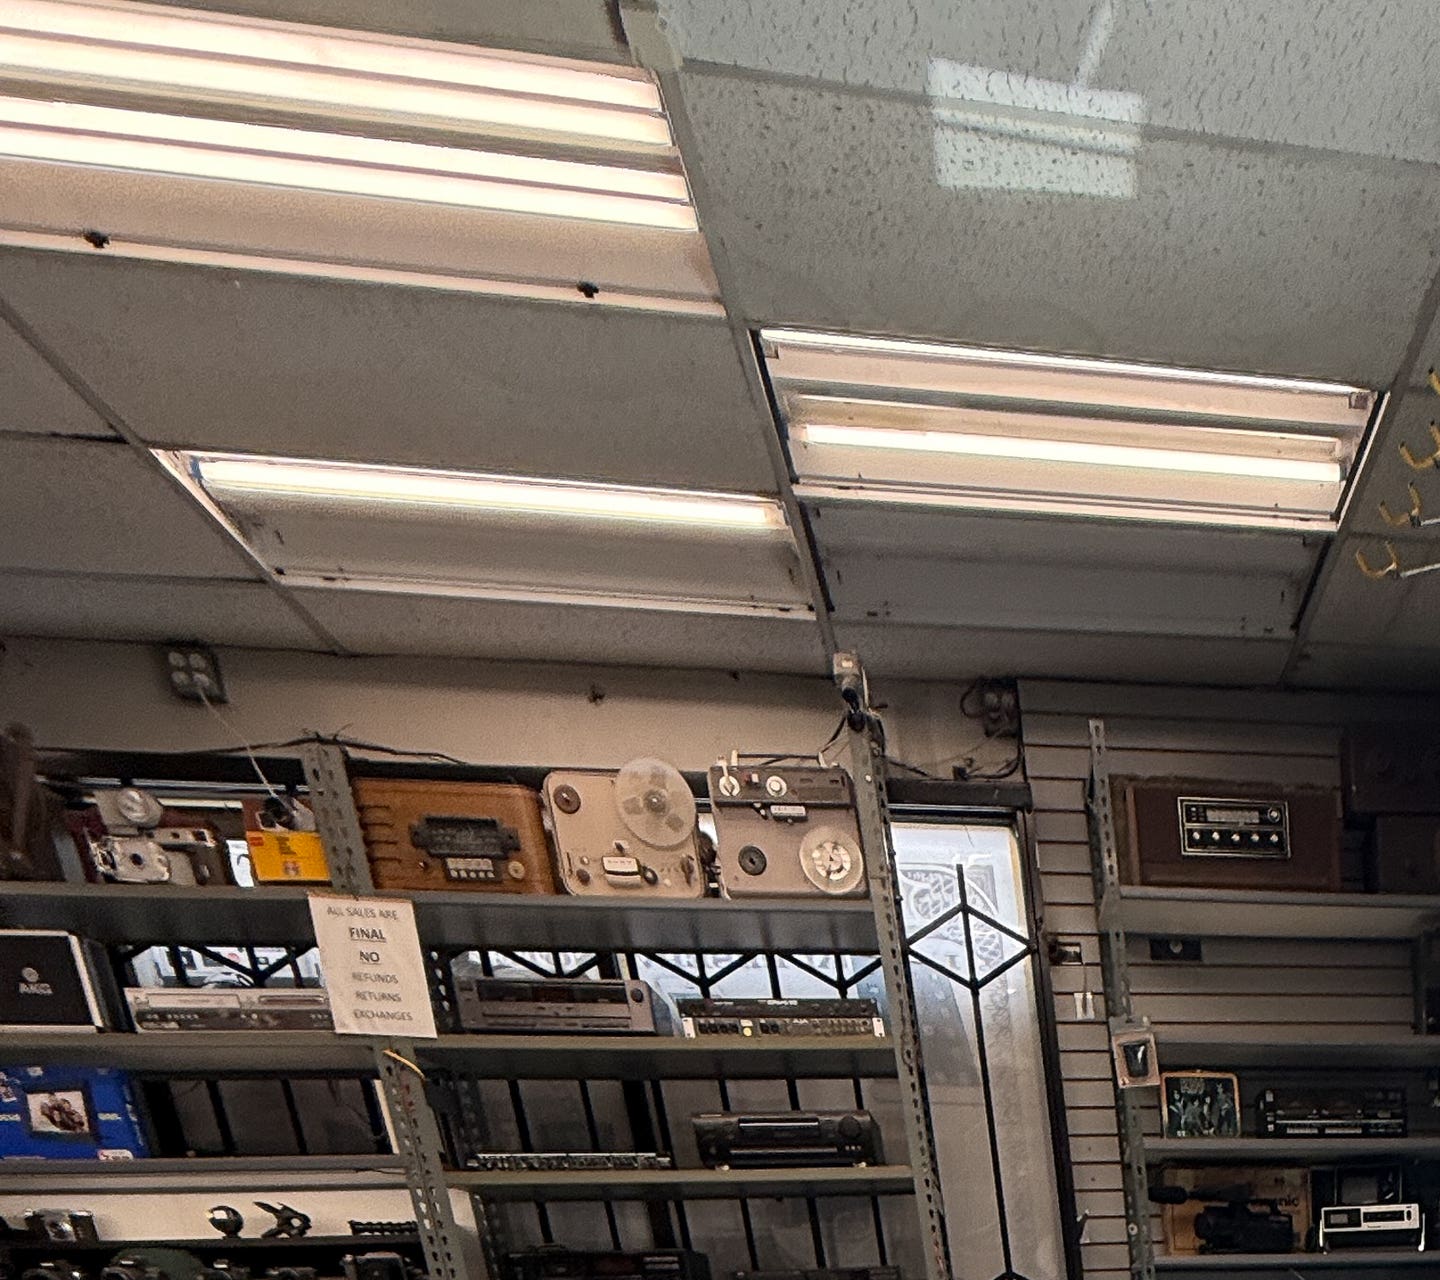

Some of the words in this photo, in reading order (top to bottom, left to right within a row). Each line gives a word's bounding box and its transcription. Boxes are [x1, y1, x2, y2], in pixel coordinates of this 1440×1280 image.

[346, 906, 376, 919] SALES
[378, 909, 399, 920] ARE
[348, 926, 387, 942] FINAL
[359, 950, 381, 963] NO
[351, 971, 399, 985] REFUNDS
[355, 990, 402, 1002] RETURNS
[353, 1008, 413, 1021] EXCHANGES
